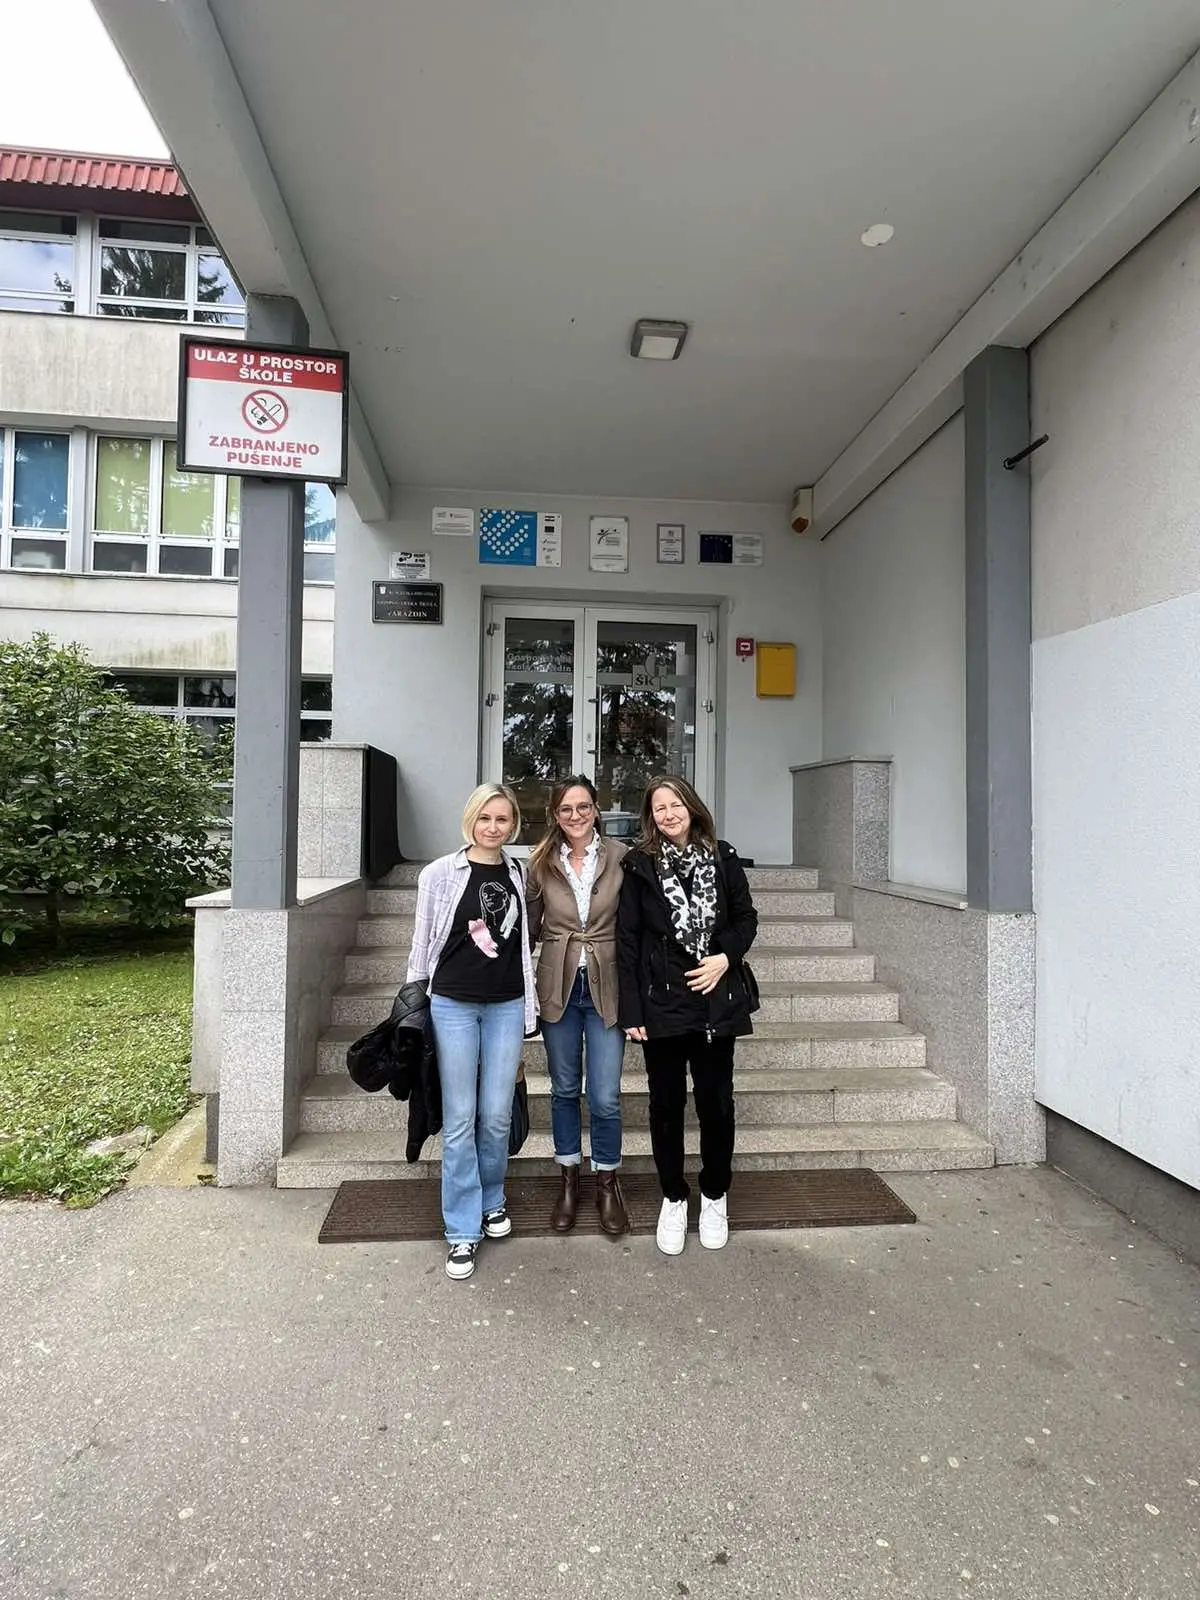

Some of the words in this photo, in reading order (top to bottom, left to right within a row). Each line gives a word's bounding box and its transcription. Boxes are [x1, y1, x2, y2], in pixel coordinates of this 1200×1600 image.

[194, 348, 237, 364] ULAZ
[243, 353, 255, 365] U
[260, 355, 337, 375] PROSTOR
[239, 364, 293, 383] ŠKOLE
[208, 435, 320, 456] ZABRANJENO
[227, 451, 303, 468] PUŠENJE
